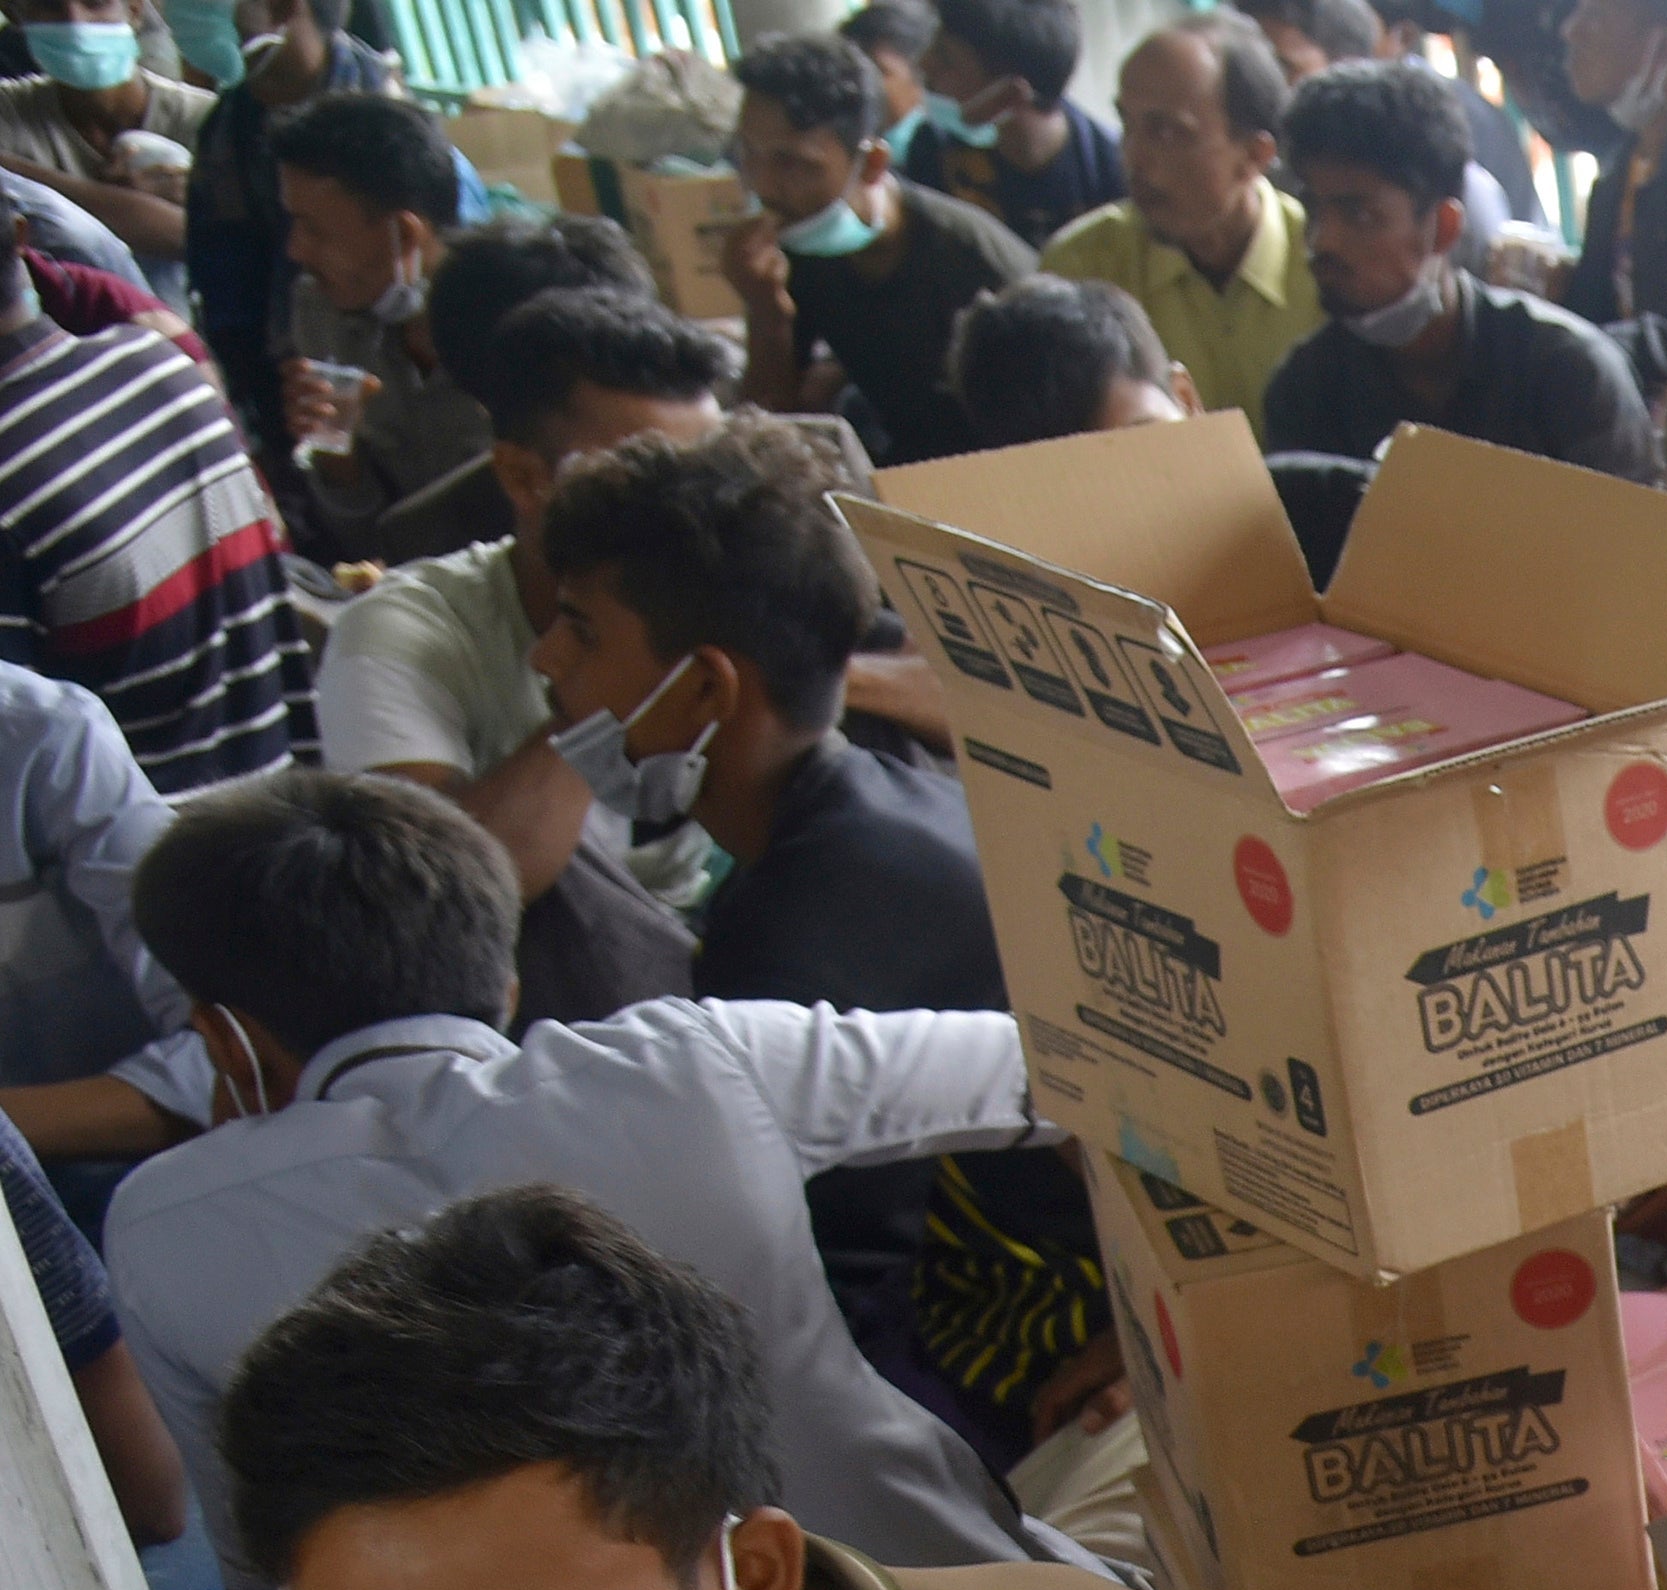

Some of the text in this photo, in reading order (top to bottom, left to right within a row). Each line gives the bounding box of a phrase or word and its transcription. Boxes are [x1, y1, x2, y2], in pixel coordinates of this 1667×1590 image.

[1622, 799, 1658, 824] 2020
[1067, 905, 1227, 1038] BALITA
[1417, 932, 1647, 1054] BALITA
[1303, 1404, 1561, 1503] BALITA
